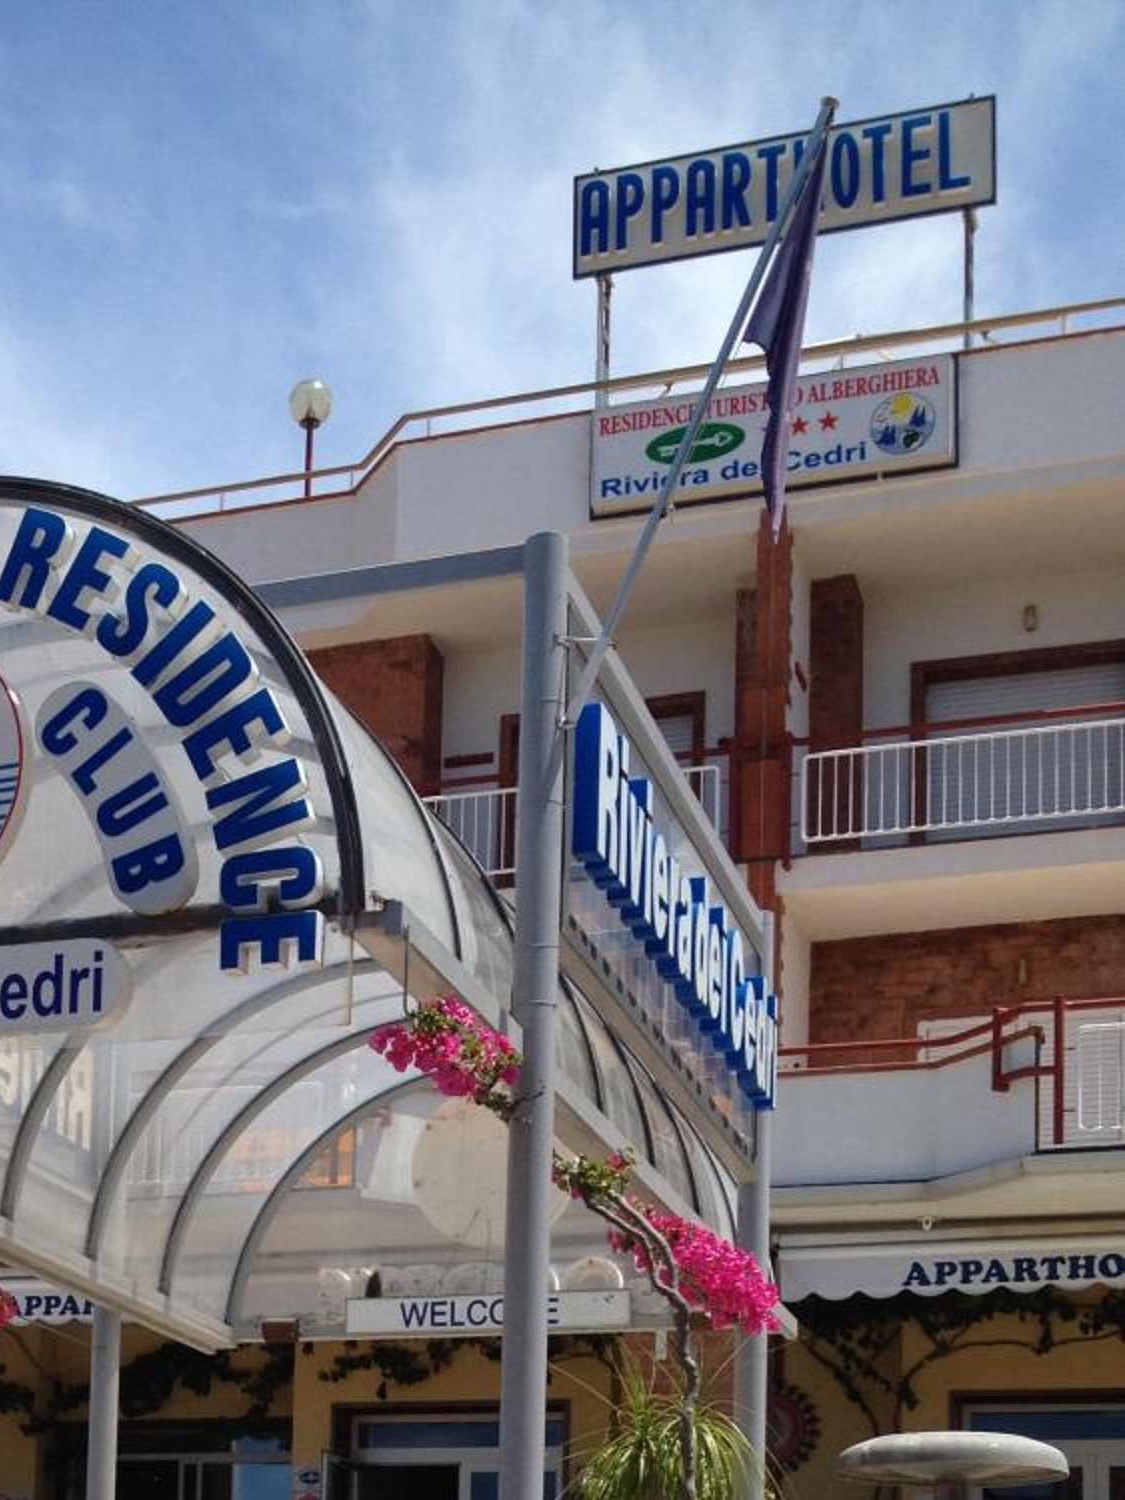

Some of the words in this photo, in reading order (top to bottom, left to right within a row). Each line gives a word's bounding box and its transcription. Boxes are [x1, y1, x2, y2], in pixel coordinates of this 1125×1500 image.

[579, 111, 971, 257] APPARTOTEL
[809, 366, 940, 404] ALBERGHIERA
[721, 460, 764, 480] de
[41, 686, 187, 894] CLUB
[575, 703, 692, 980] Riviera
[400, 1298, 560, 1329] WELCOE
